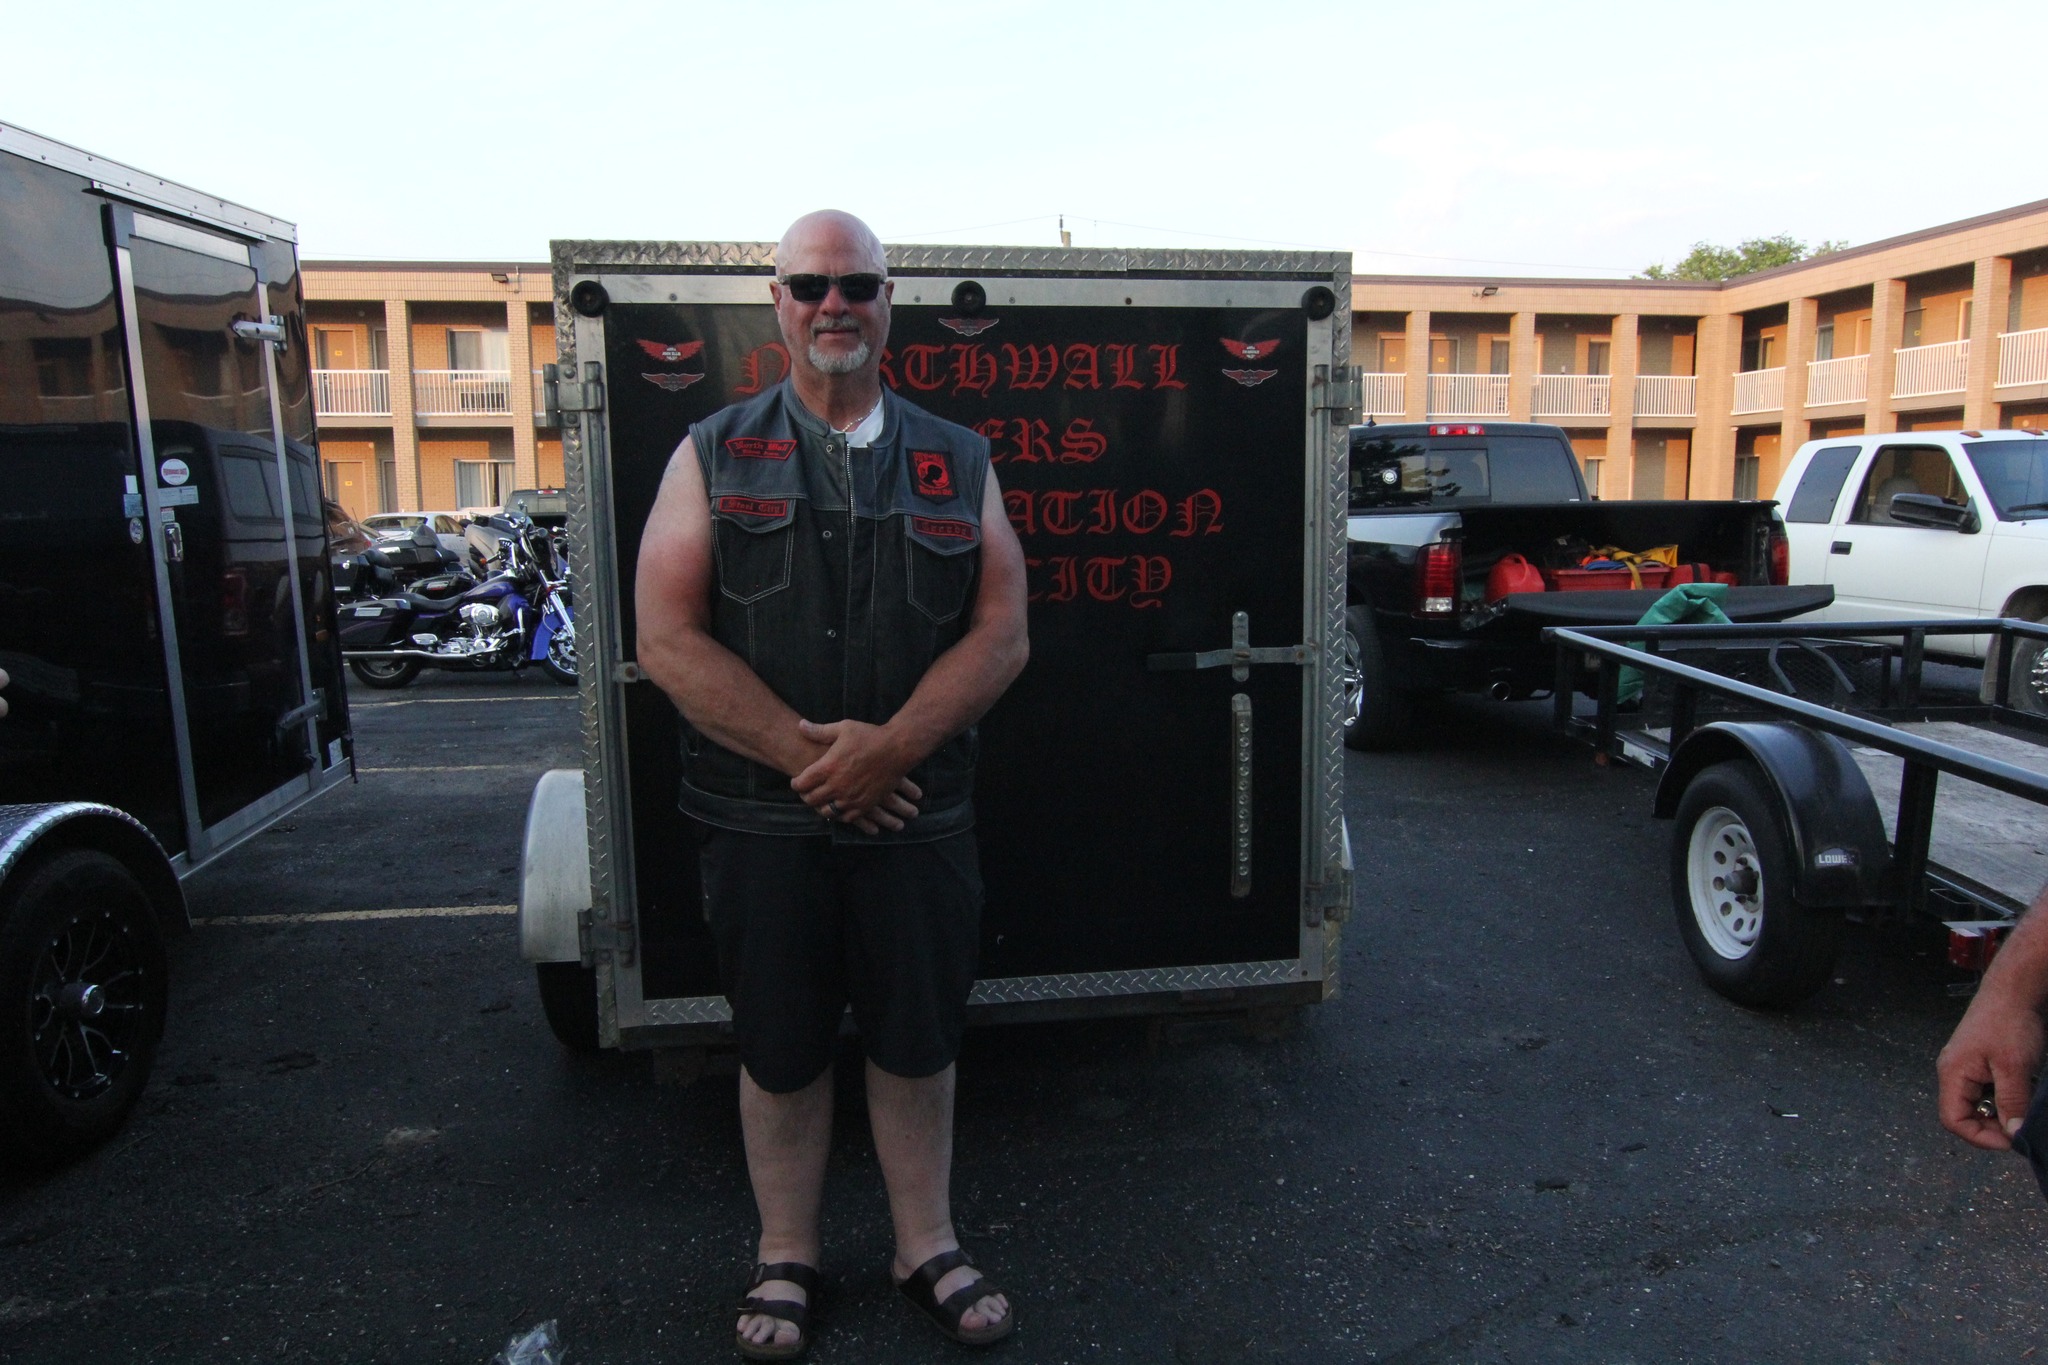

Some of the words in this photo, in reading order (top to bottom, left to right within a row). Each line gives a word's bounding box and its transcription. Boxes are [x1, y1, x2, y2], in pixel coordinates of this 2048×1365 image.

[733, 340, 1189, 398] NTHWALL
[970, 416, 1108, 465] ERS
[1002, 487, 1225, 538] ATION
